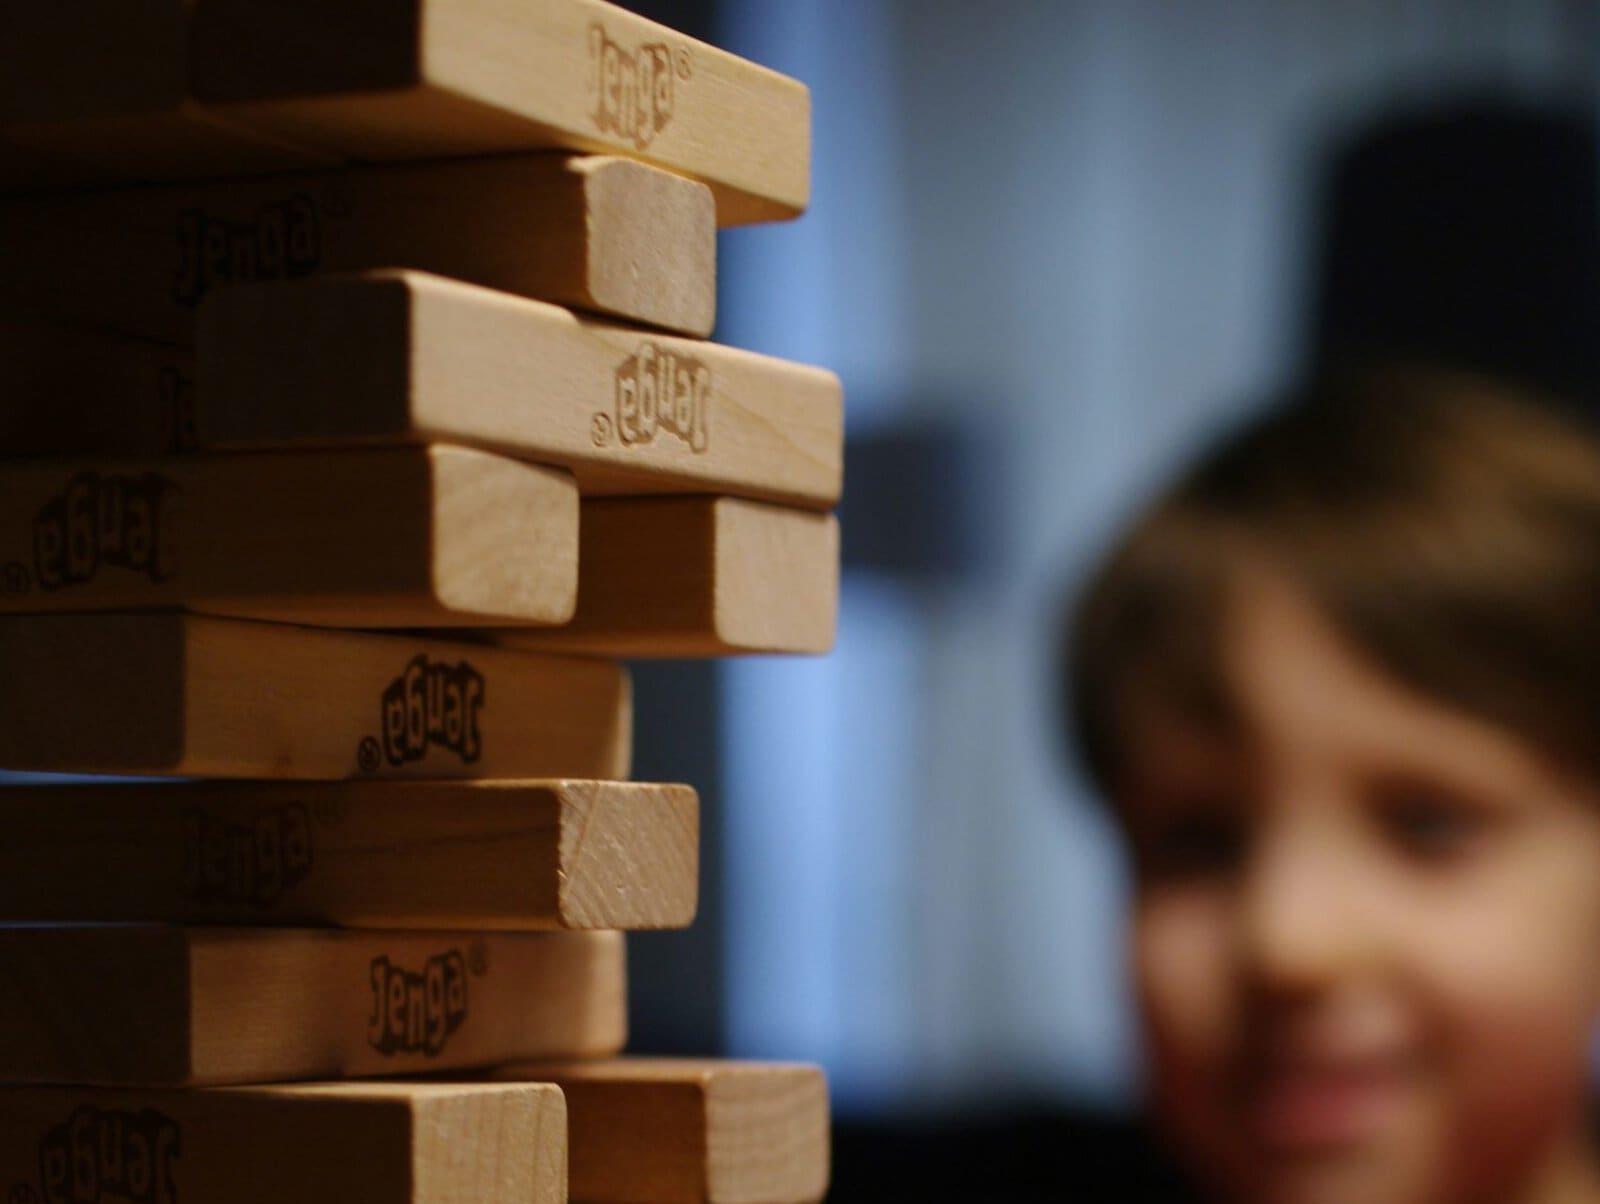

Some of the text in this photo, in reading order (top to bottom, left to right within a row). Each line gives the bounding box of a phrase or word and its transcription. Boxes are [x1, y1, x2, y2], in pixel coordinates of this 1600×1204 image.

[586, 20, 674, 152] Jenga
[613, 342, 713, 455] Jenga
[33, 470, 181, 592] Jenga
[381, 653, 486, 766] Jenga
[368, 947, 470, 1059] Jenga
